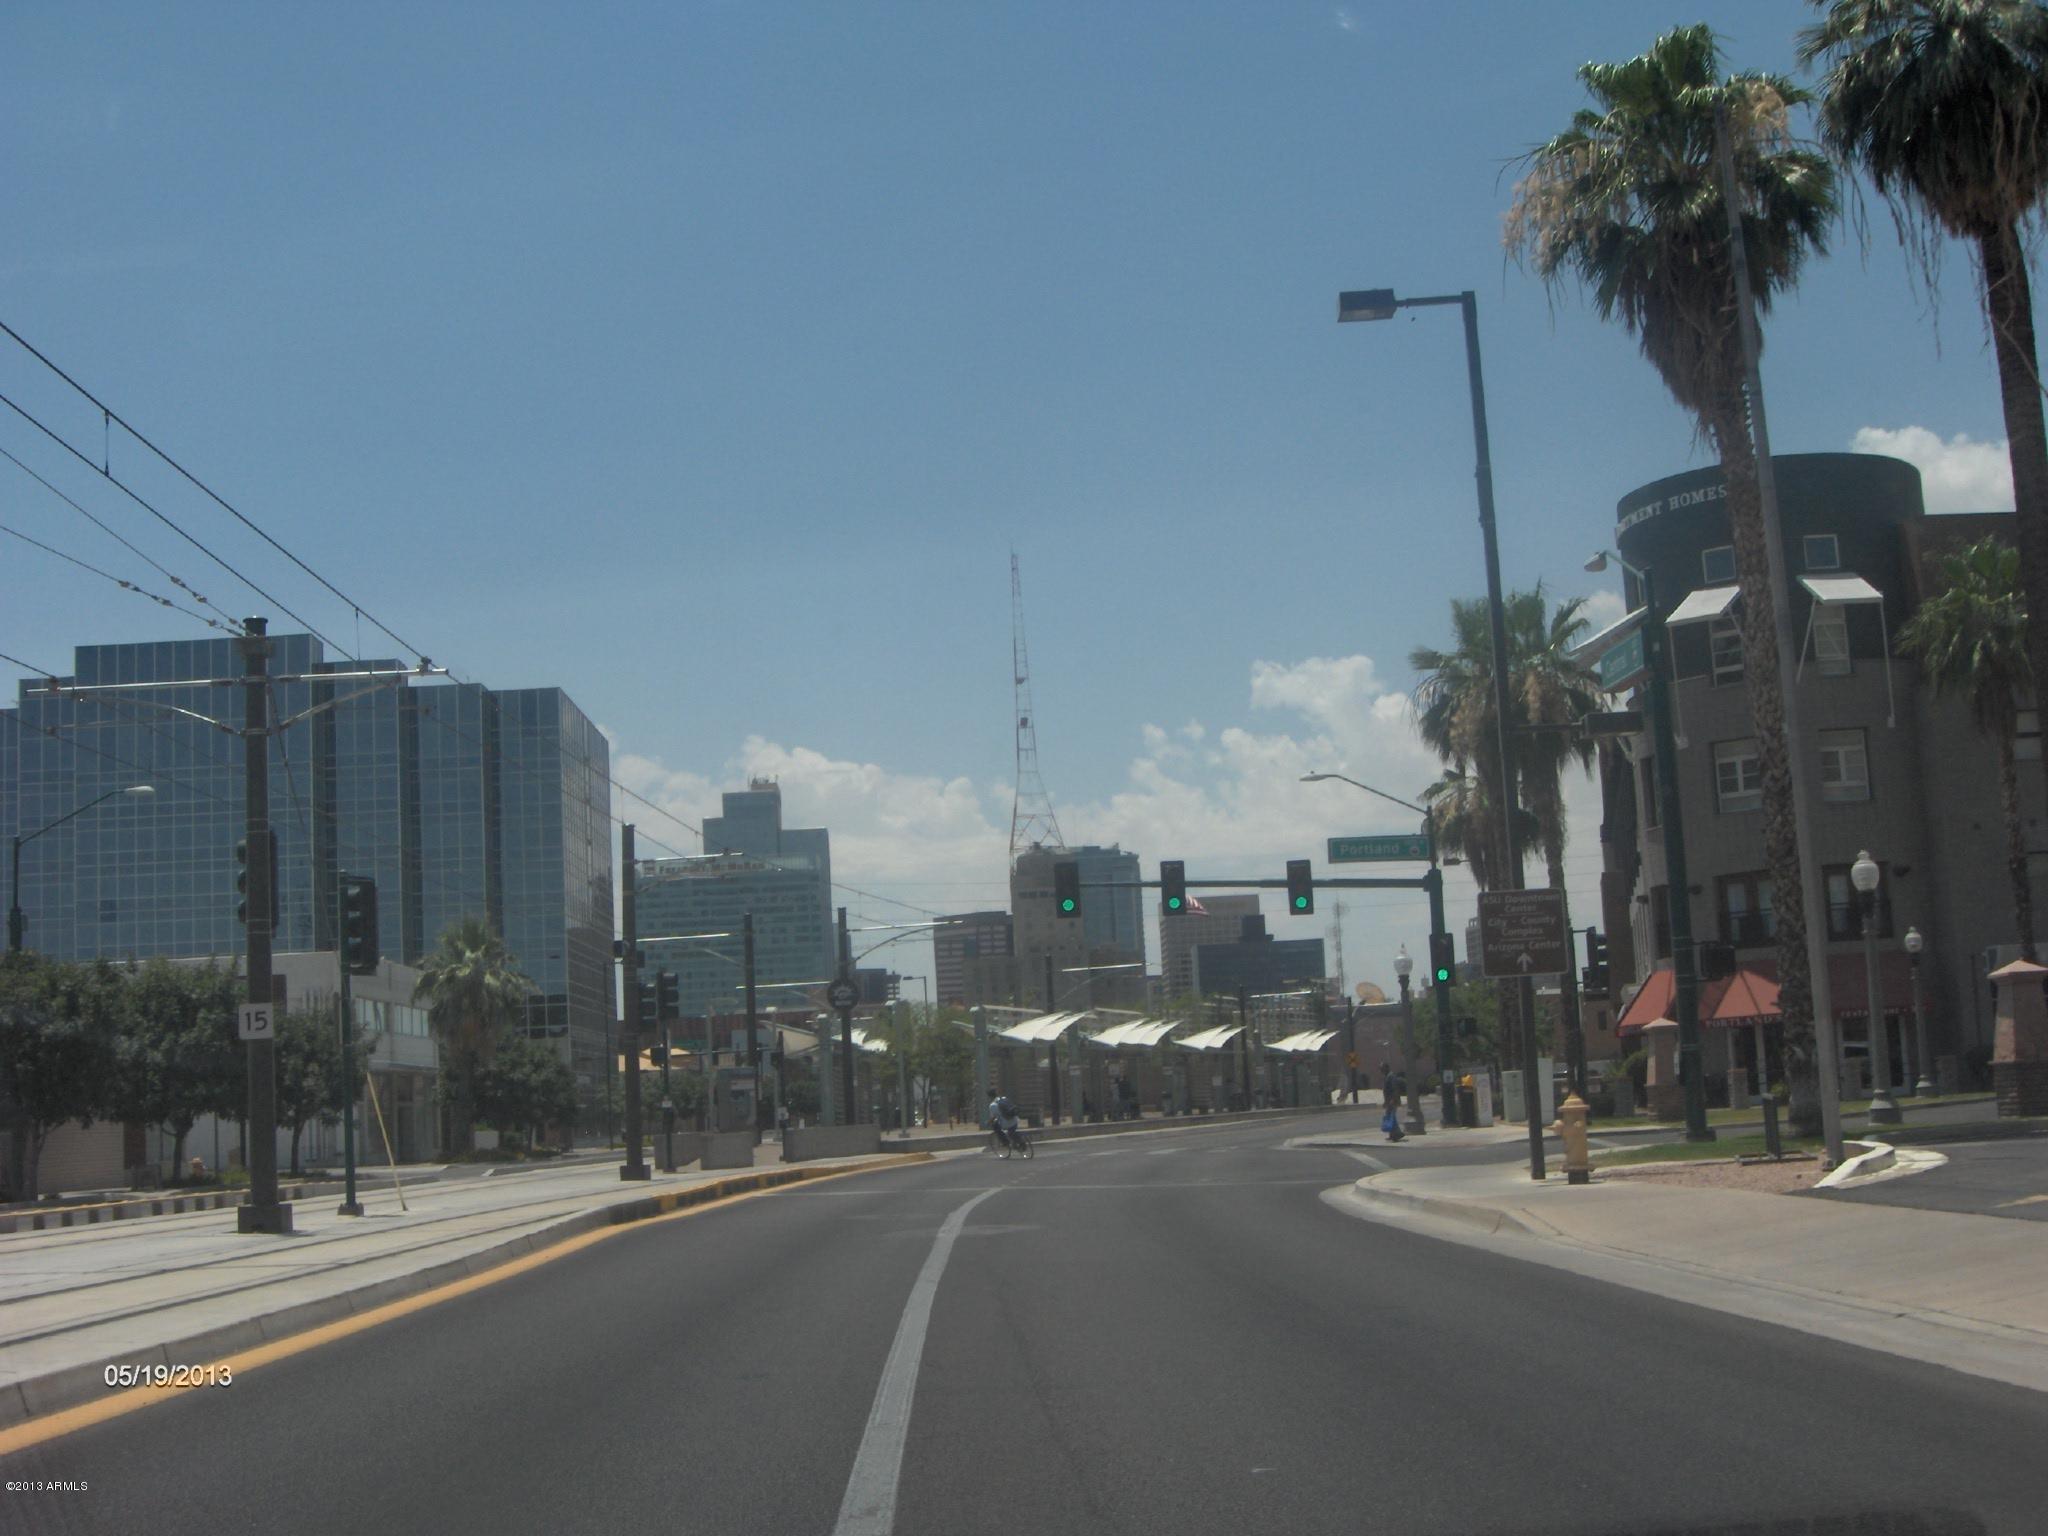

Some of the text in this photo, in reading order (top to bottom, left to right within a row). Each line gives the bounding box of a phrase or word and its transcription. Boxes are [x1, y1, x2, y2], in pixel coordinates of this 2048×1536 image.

[1667, 484, 1728, 512] HOMES
[1339, 843, 1401, 857] Portland
[1503, 904, 1537, 913] Center
[1487, 917, 1508, 927] City
[1520, 915, 1557, 926] County
[1487, 941, 1561, 952] Arizona Center
[245, 1010, 268, 1031] 15
